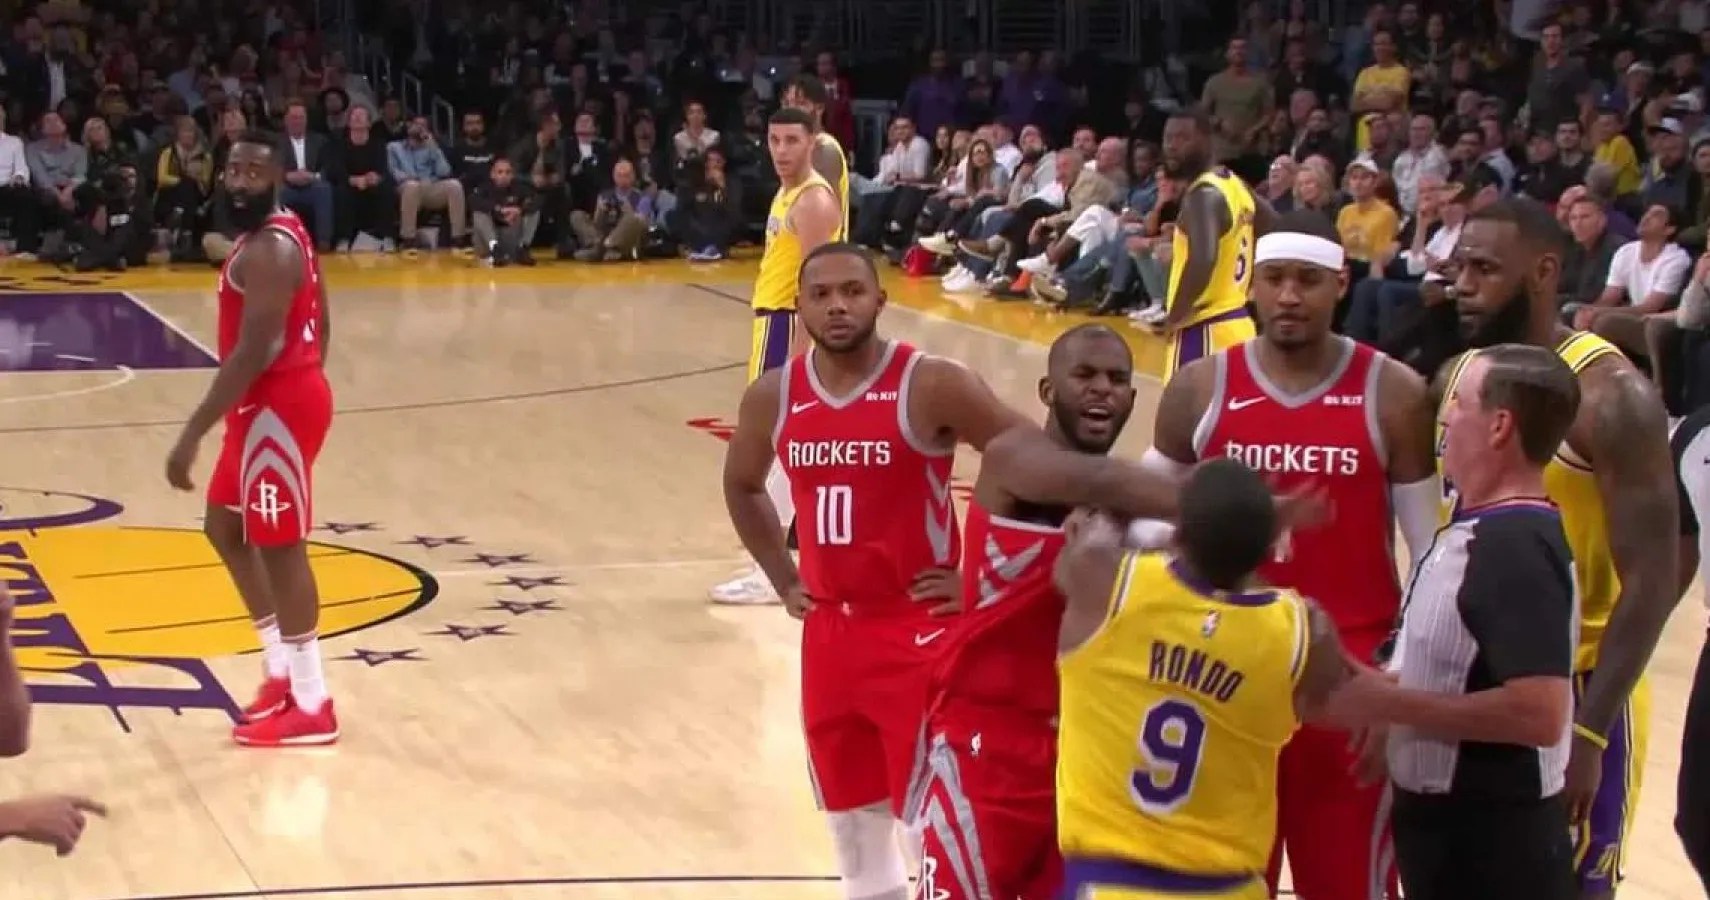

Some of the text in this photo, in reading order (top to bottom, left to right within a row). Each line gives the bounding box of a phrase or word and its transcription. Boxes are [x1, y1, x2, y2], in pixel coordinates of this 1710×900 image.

[787, 439, 891, 468] ROCKETS
[1225, 440, 1359, 475] ROCKETS
[816, 485, 853, 545] 10
[1149, 639, 1245, 703] RONDO
[1128, 697, 1207, 816] 9
